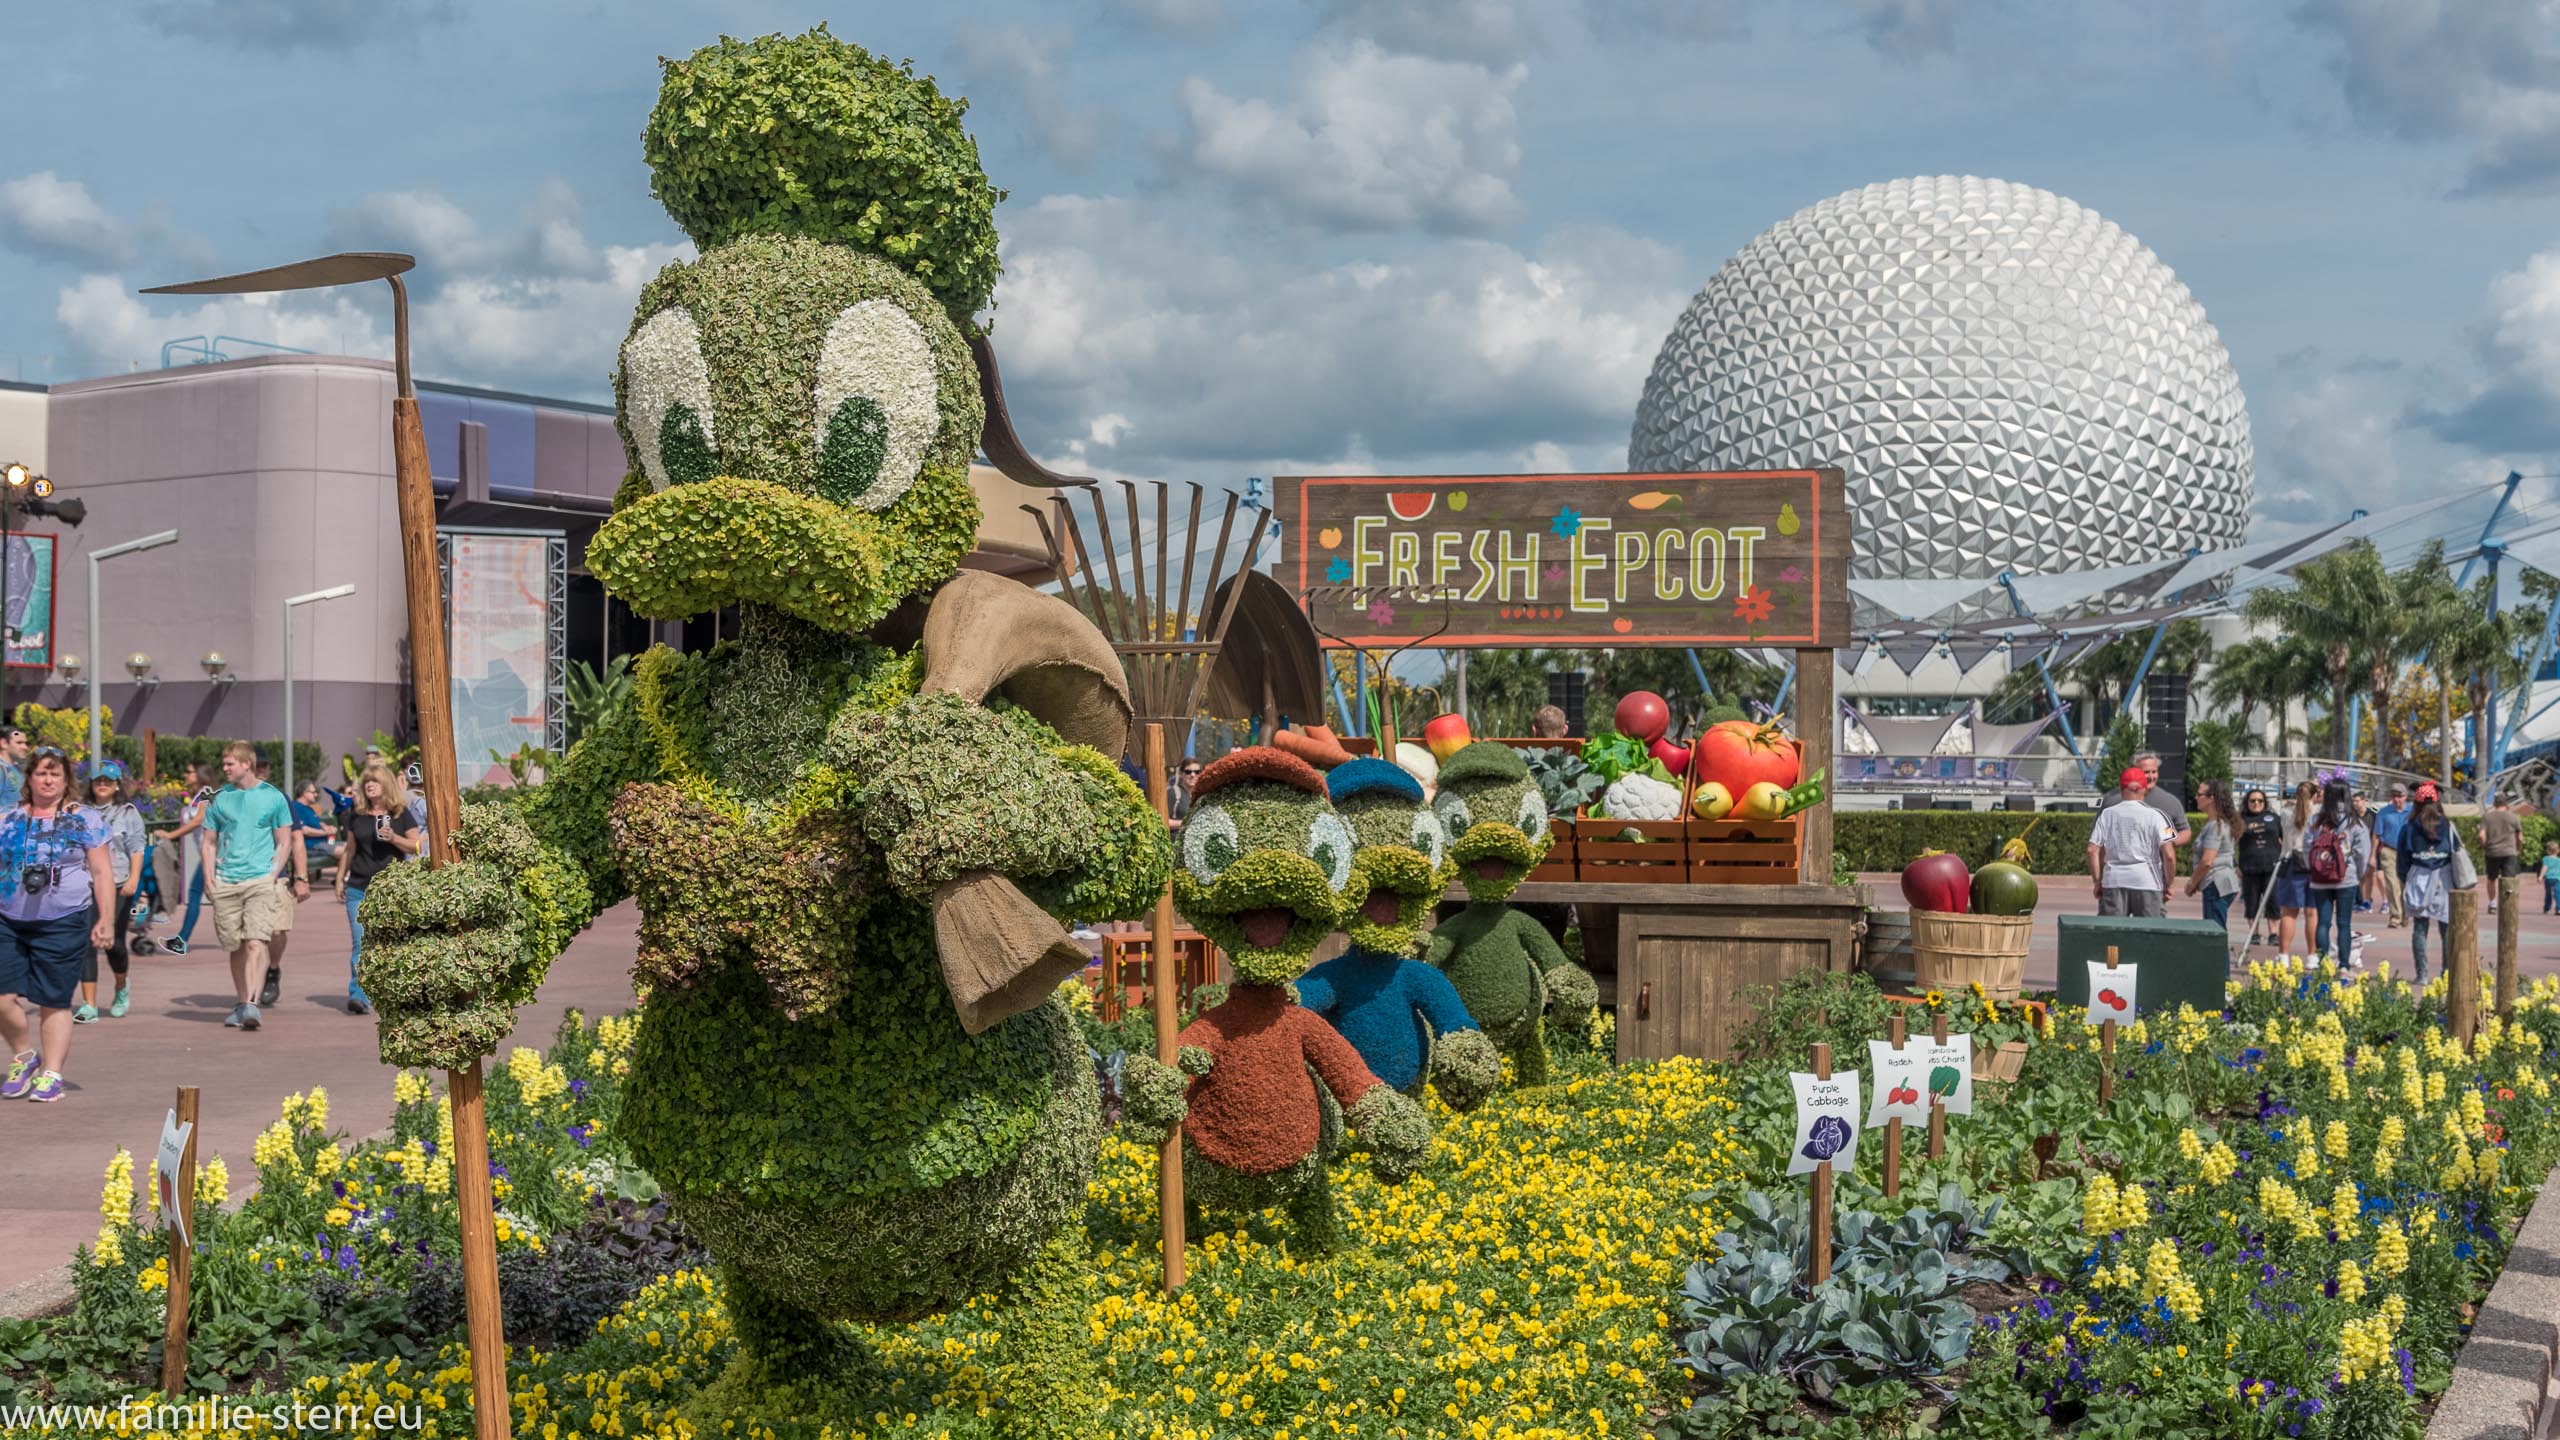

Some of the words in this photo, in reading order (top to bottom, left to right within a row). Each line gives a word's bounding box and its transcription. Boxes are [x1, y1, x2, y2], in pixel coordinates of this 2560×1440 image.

[1353, 515, 1540, 611] FRESH
[1570, 517, 1766, 612] EPCOT
[1888, 1058, 1913, 1067] Radish
[1941, 1055, 1966, 1063] Chard
[1812, 1085, 1840, 1095] Purple
[1807, 1096, 1849, 1107] Cabbage
